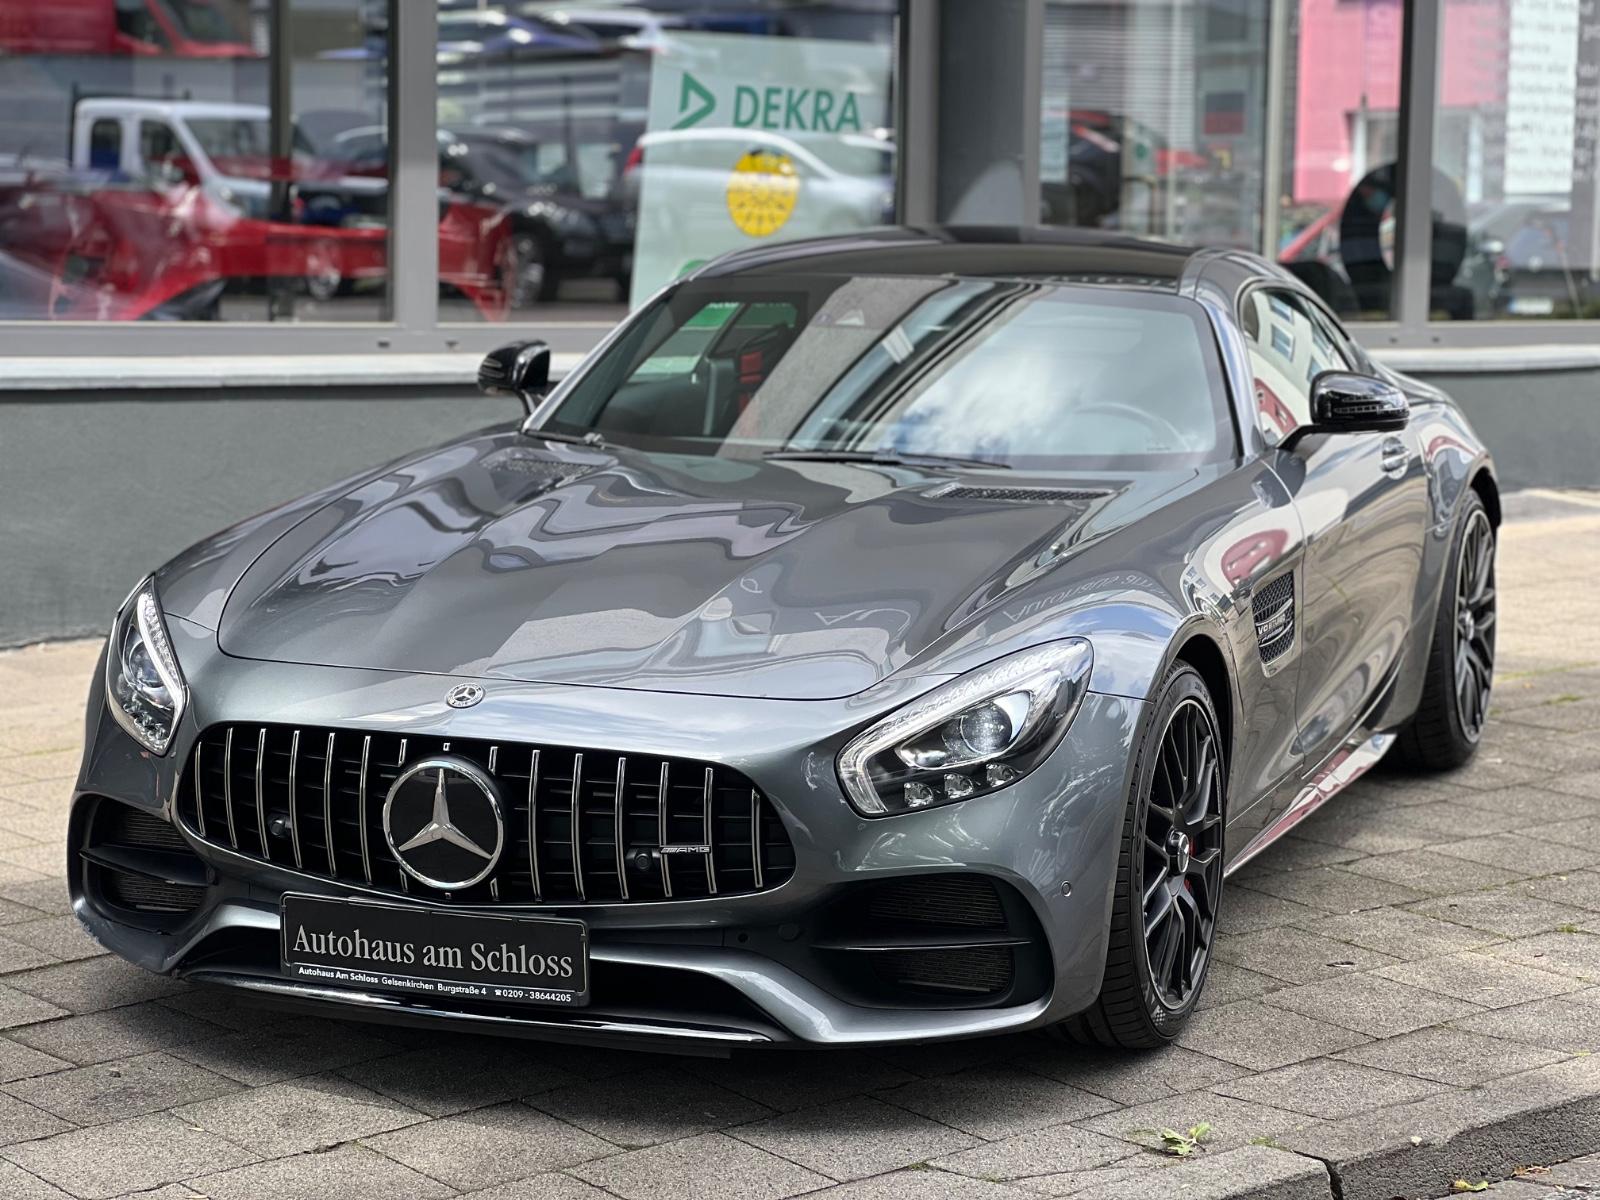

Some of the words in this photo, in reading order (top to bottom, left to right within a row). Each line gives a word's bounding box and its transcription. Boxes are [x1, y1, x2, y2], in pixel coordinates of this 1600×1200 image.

[732, 85, 861, 132] DEKRA
[293, 924, 415, 965] Autohaus
[421, 944, 464, 969] am
[470, 942, 574, 978] Schloss
[298, 966, 335, 978] Autohaus
[335, 971, 349, 980] Am
[350, 973, 379, 984] Schloss
[381, 976, 434, 990] Gelsenkirchen
[437, 983, 480, 995] Burgstraße
[480, 987, 487, 995] 4
[529, 991, 572, 1002] 38644205
